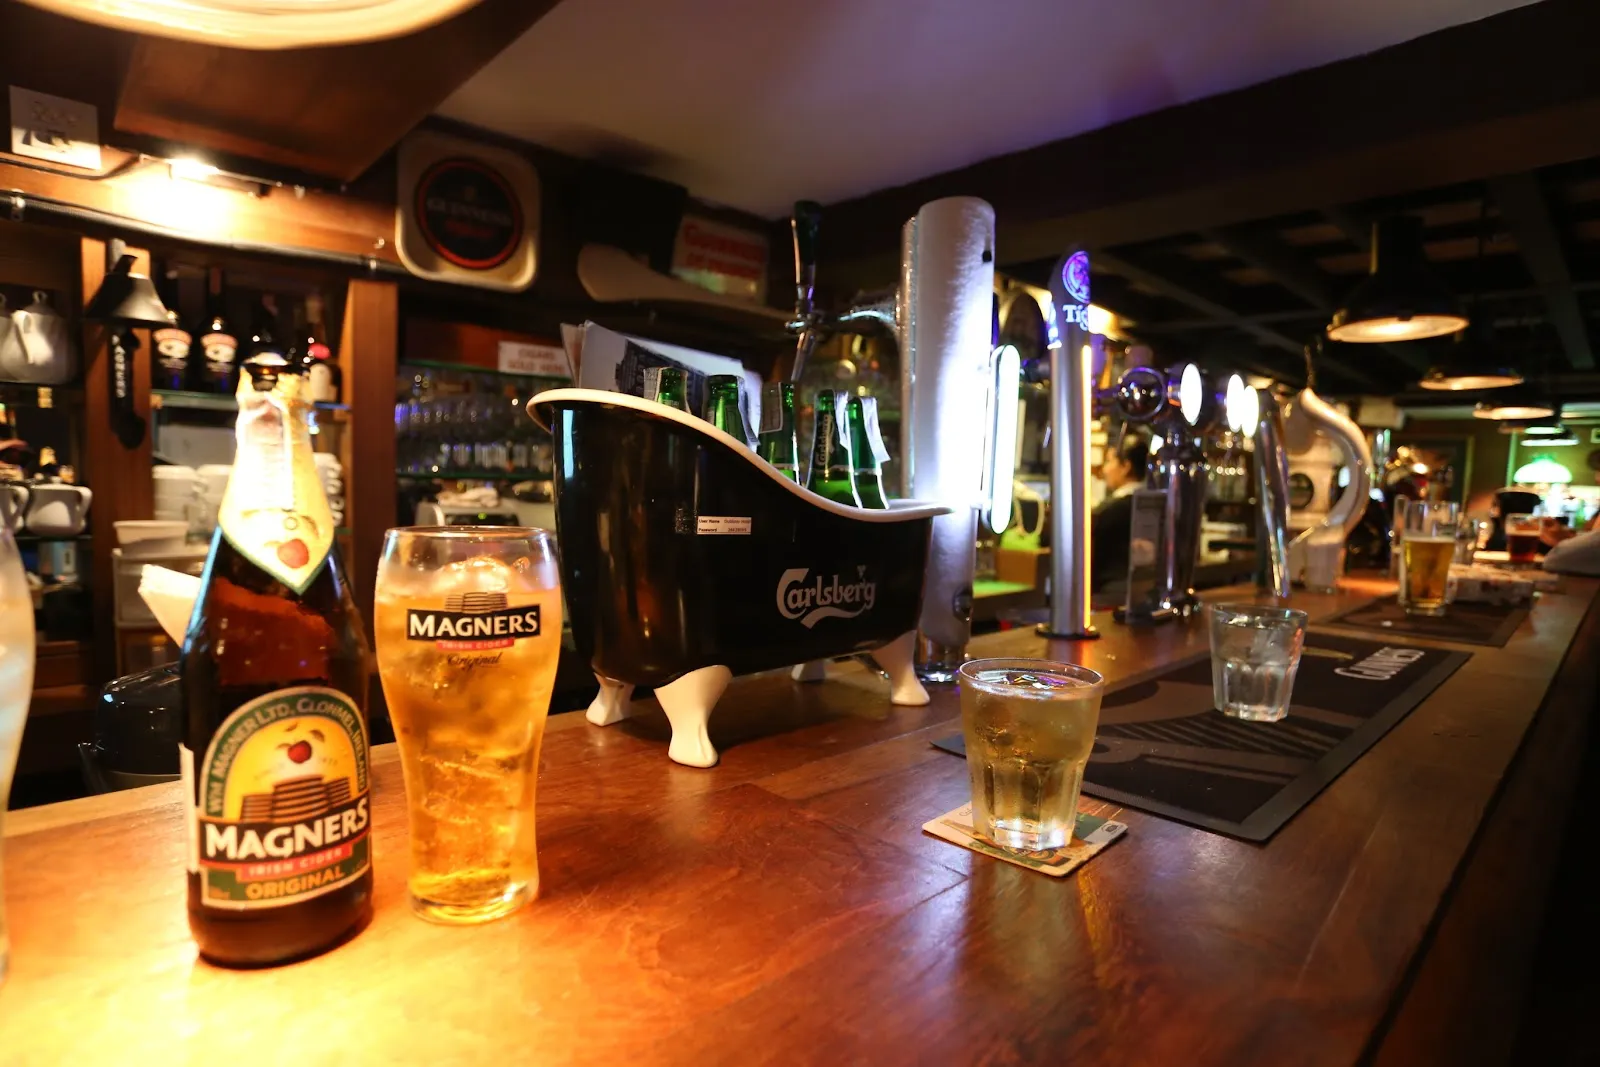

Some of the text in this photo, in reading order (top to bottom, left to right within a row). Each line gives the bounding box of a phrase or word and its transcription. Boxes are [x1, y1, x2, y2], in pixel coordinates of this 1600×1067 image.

[1062, 304, 1089, 331] Tig
[776, 567, 876, 624] Carlsberg
[409, 611, 538, 638] MAGNERS
[446, 652, 501, 671] Original
[204, 797, 369, 860] MAGNERS
[249, 847, 343, 877] IRISH CIDER
[245, 865, 345, 900] ORIGINAL
